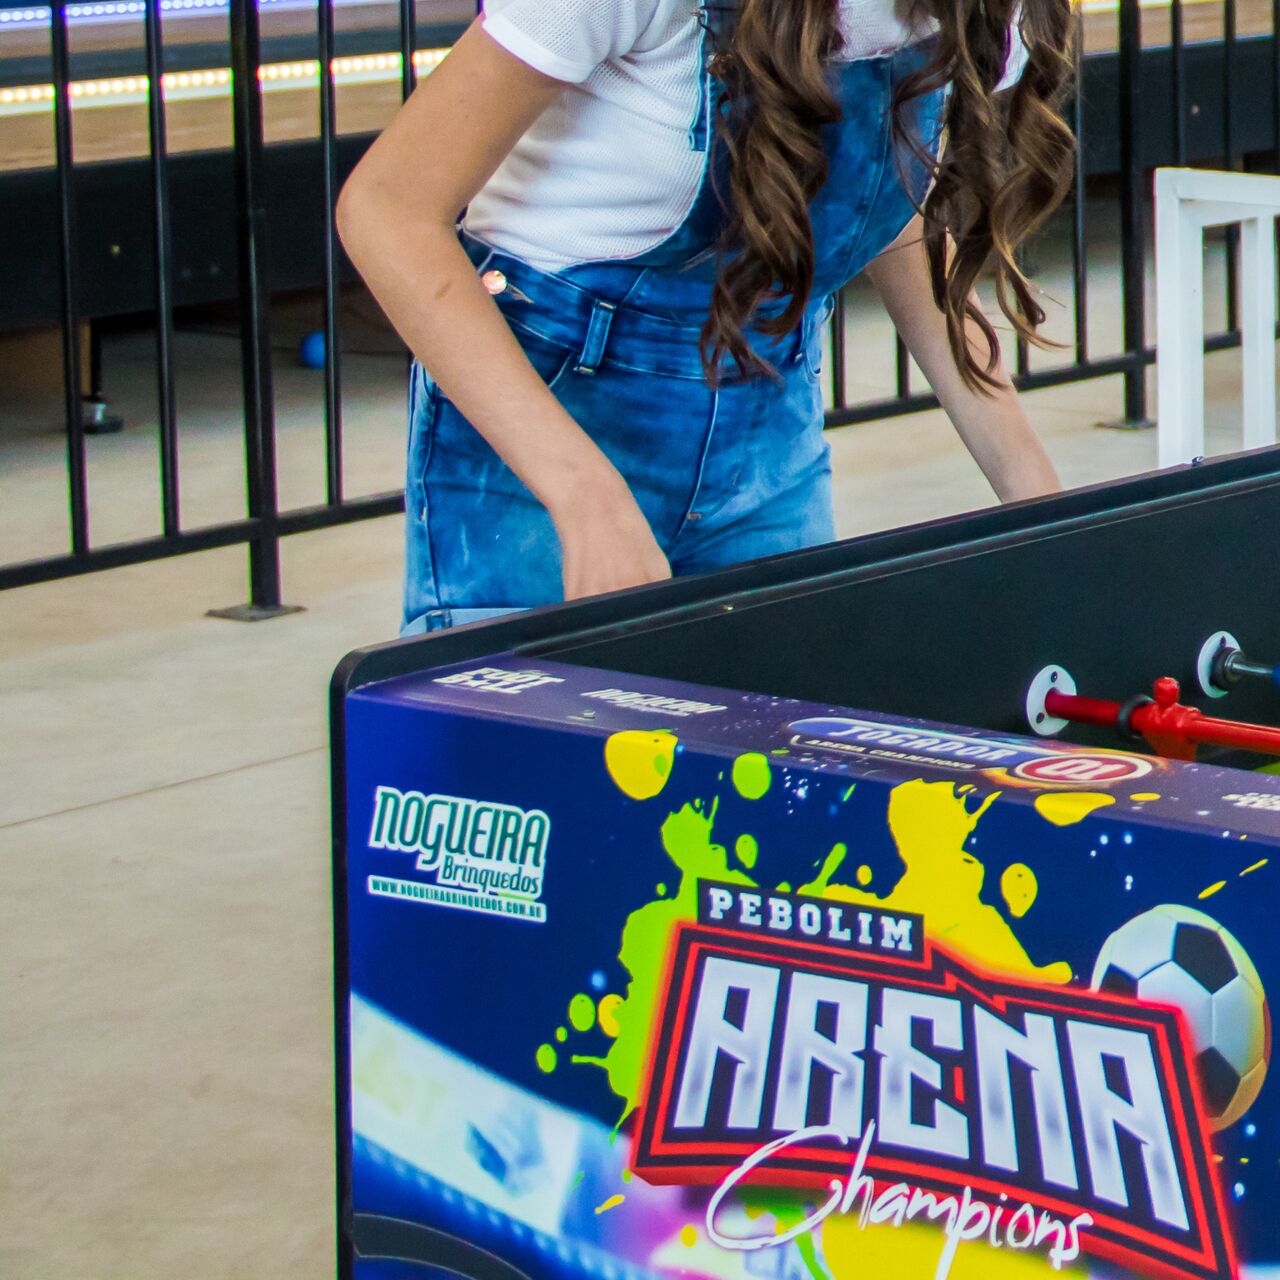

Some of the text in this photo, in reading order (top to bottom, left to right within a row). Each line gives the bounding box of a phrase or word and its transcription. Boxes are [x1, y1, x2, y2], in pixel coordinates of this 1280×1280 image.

[804, 738, 977, 769] ARENA CHAMPIONS
[829, 725, 1019, 762] JOGADOR
[1034, 757, 1122, 780] 01
[373, 790, 547, 868] NOGUEIRA
[441, 854, 541, 895] Brinquedos
[707, 887, 914, 952] PEBOLIM
[673, 956, 1190, 1232] ARENA
[706, 1119, 1094, 1280] Champions
